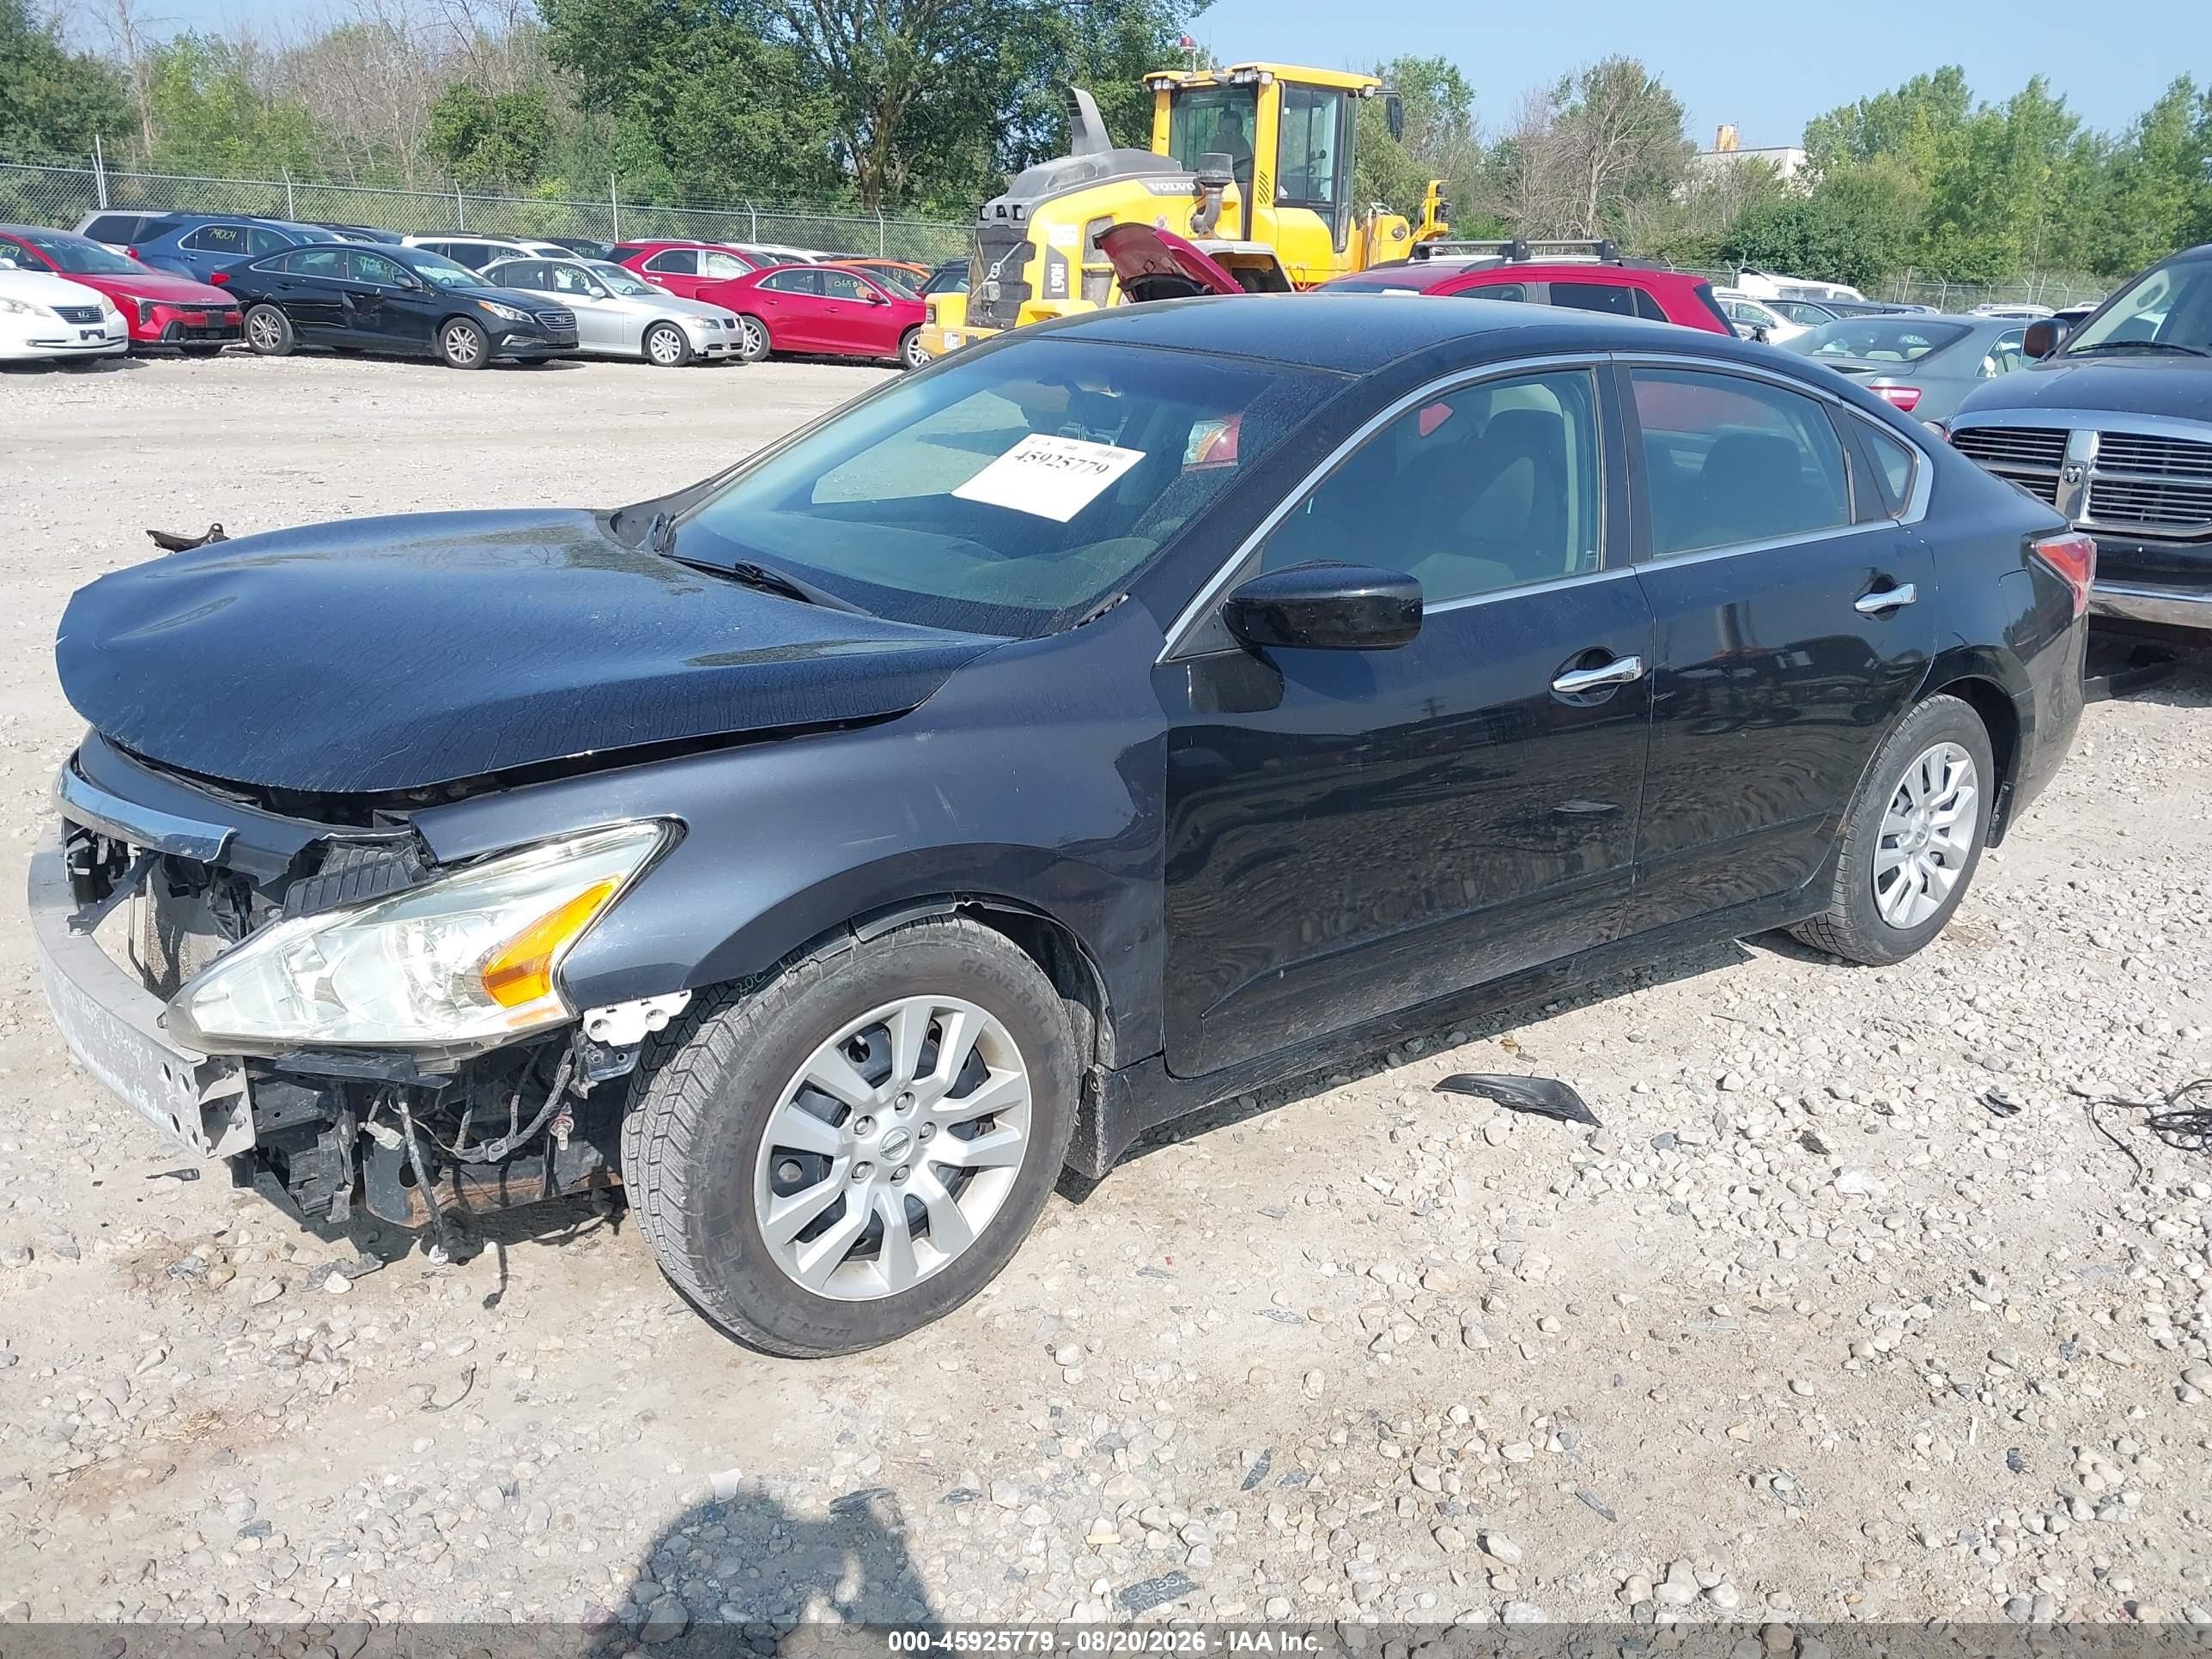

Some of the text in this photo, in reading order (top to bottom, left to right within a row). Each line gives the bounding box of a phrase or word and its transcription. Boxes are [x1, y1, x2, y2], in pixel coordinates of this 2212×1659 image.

[1147, 182, 1195, 191] VOLVO
[1050, 263, 1065, 292] L90H
[1014, 450, 1109, 475] 45925779
[958, 959, 1048, 1034] GENERAL
